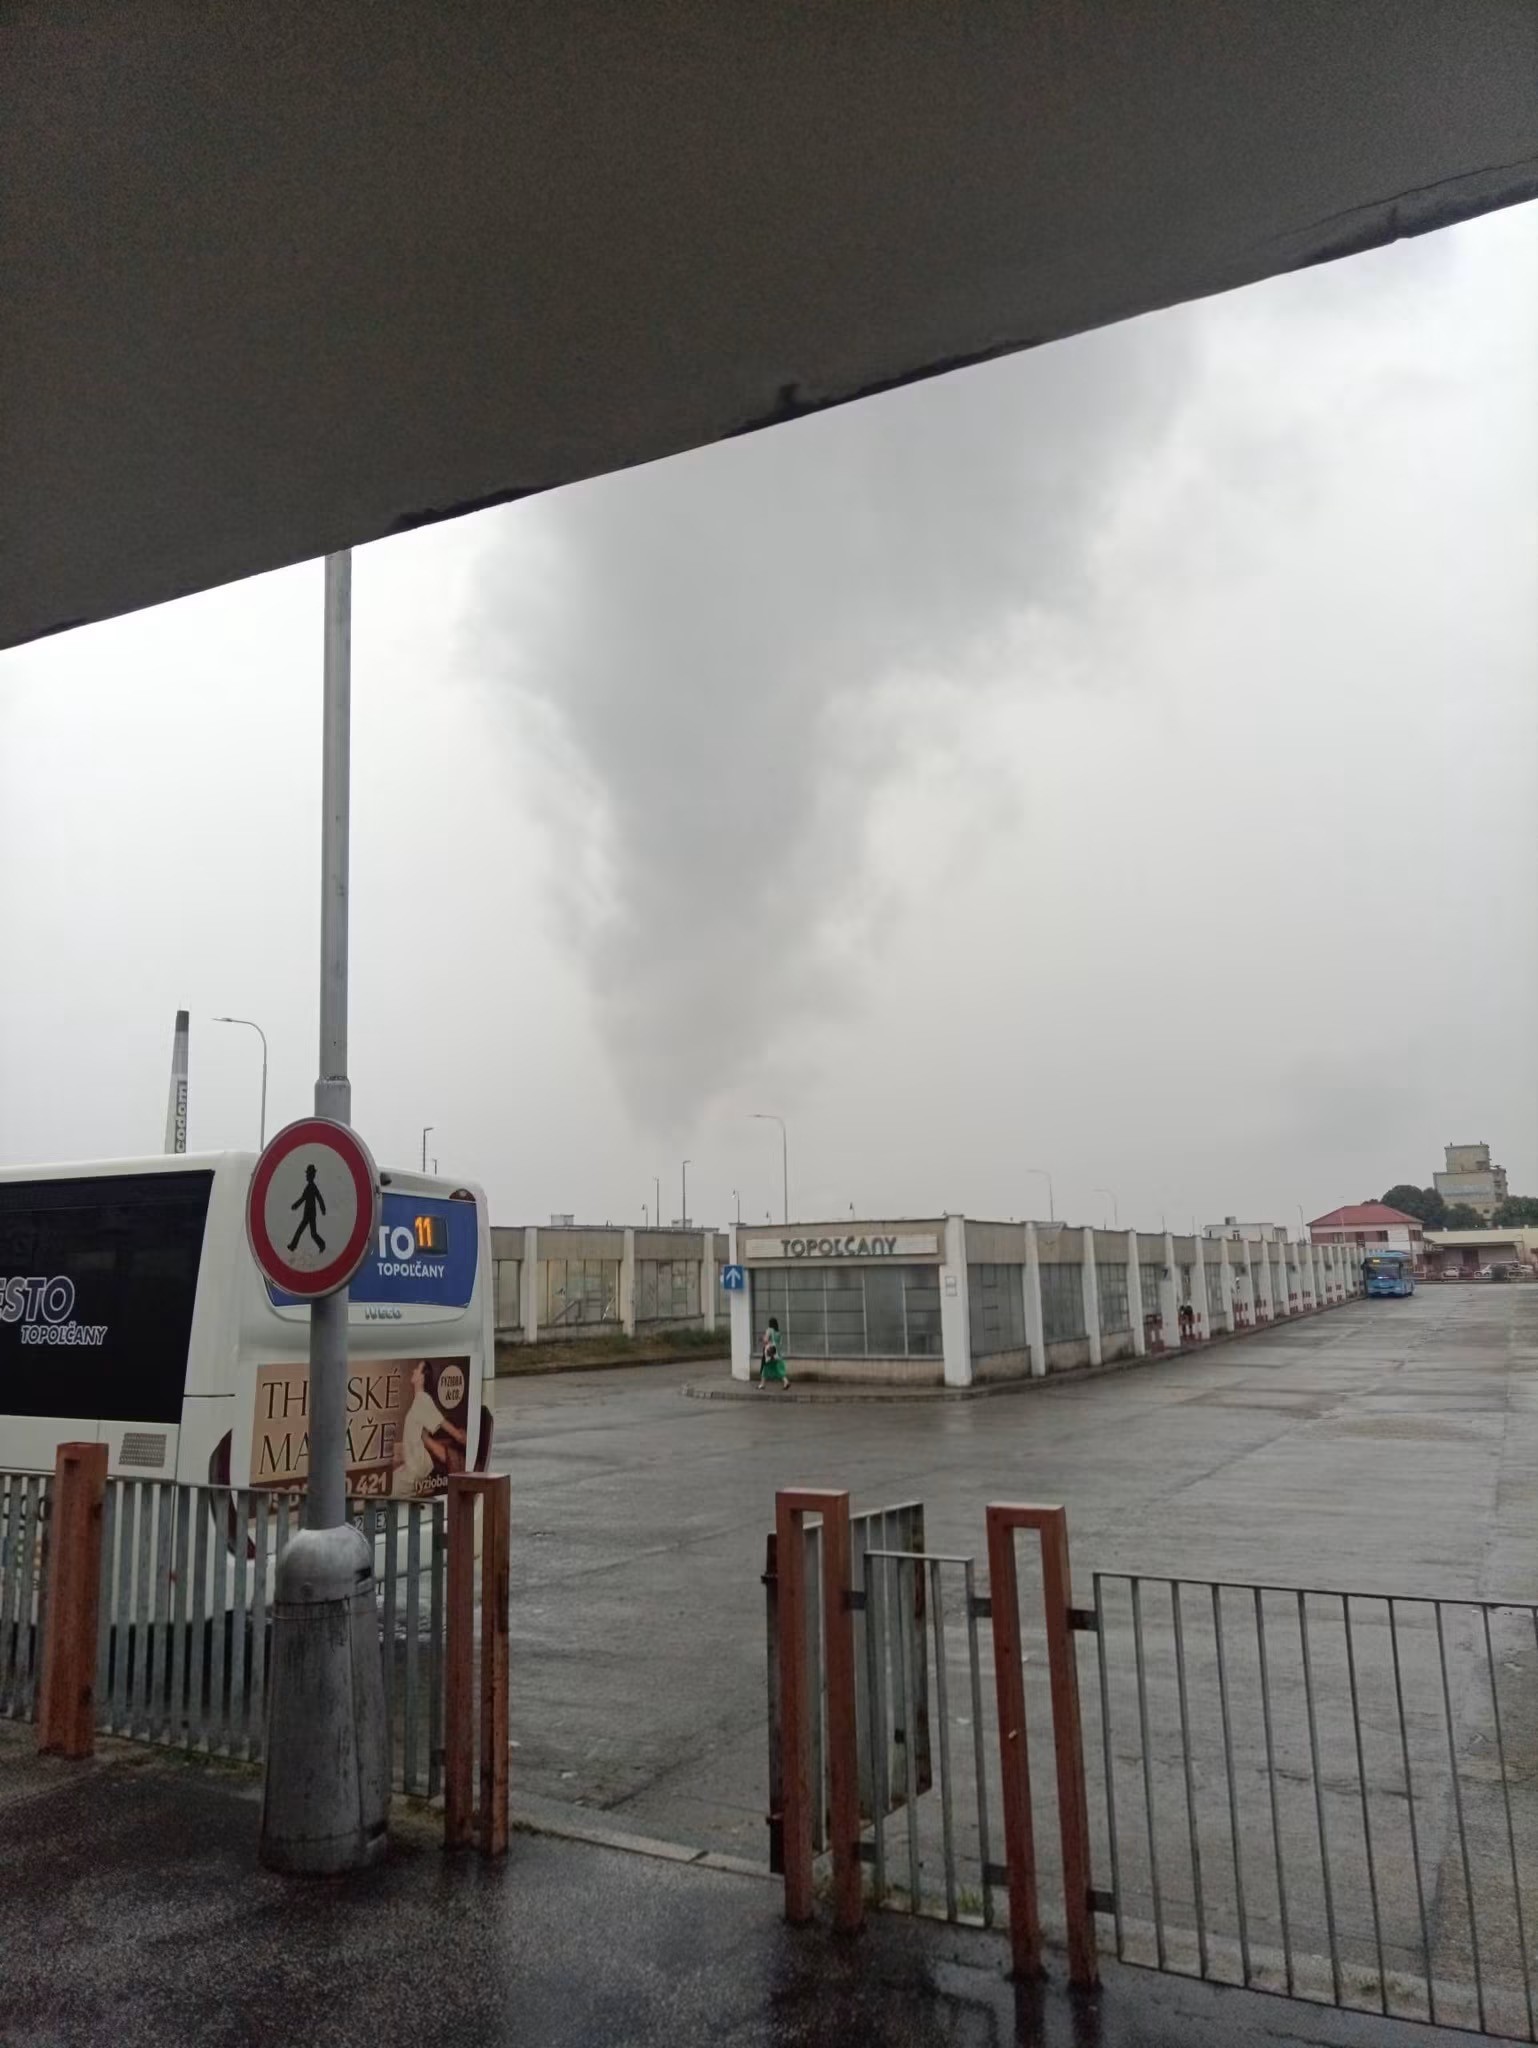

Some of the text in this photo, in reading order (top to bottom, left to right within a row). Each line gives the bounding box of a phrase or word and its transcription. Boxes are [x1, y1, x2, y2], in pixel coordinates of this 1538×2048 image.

[371, 1226, 415, 1260] TO
[415, 1216, 432, 1248] 11
[377, 1261, 445, 1278] TOPOĽČANY
[262, 1367, 401, 1419] THSKÉ
[356, 1471, 387, 1495] 421
